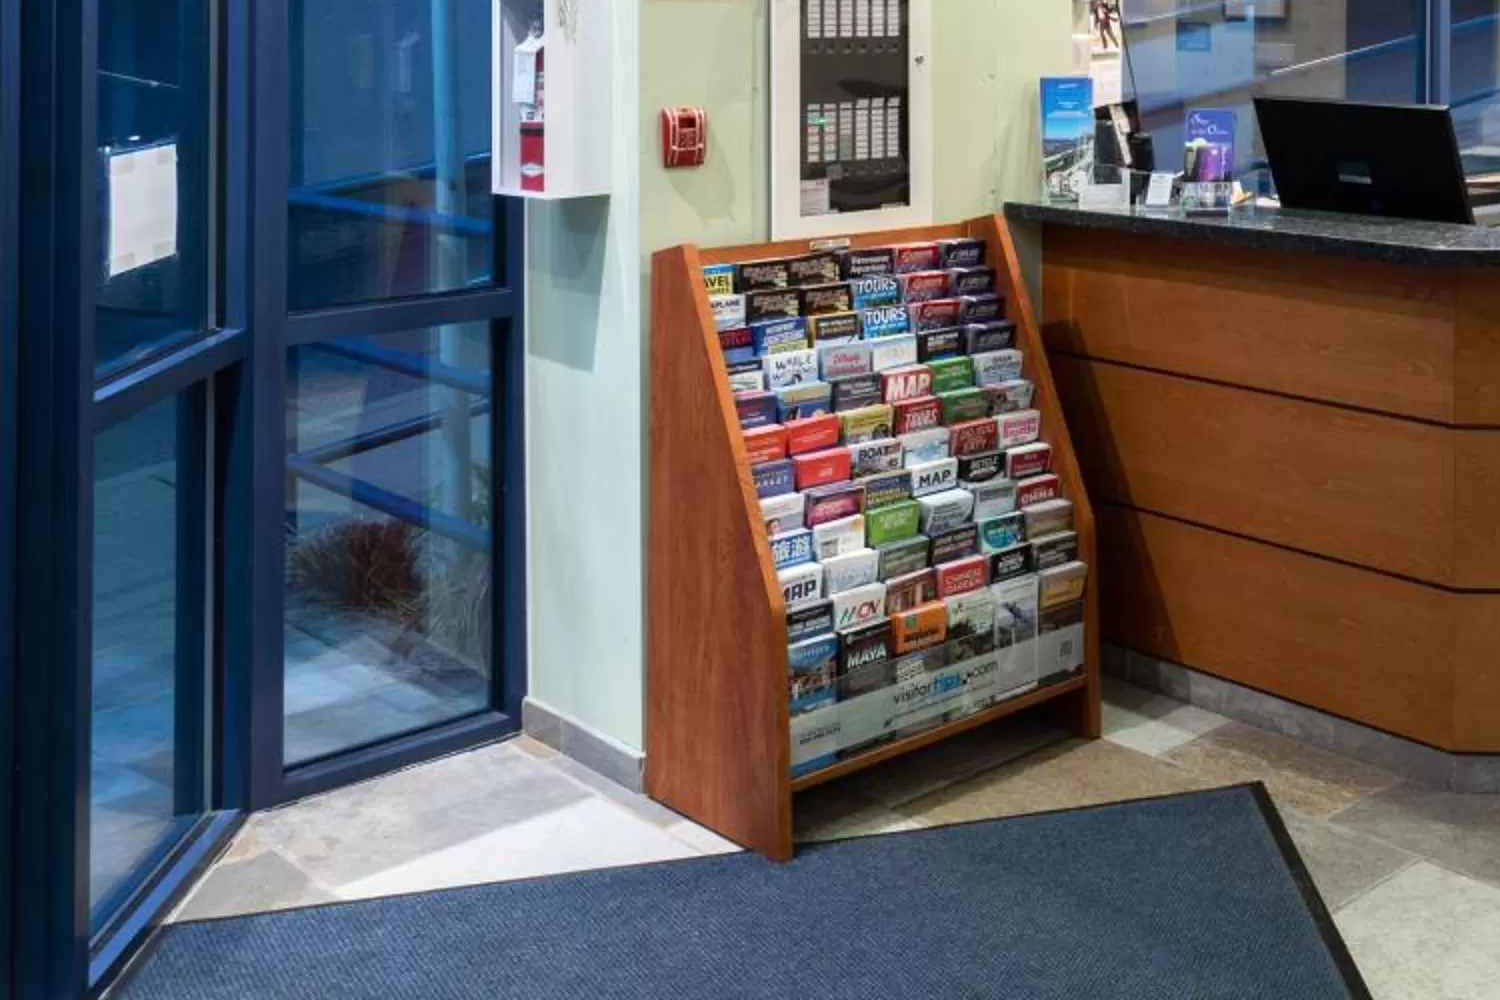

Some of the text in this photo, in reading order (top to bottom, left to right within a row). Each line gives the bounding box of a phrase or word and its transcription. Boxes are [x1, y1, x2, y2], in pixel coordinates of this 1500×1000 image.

[858, 278, 897, 294] TOURS
[866, 308, 907, 324] TOURS
[886, 374, 931, 400] MAP
[919, 470, 950, 488] MAP
[847, 641, 887, 669] MAYA
